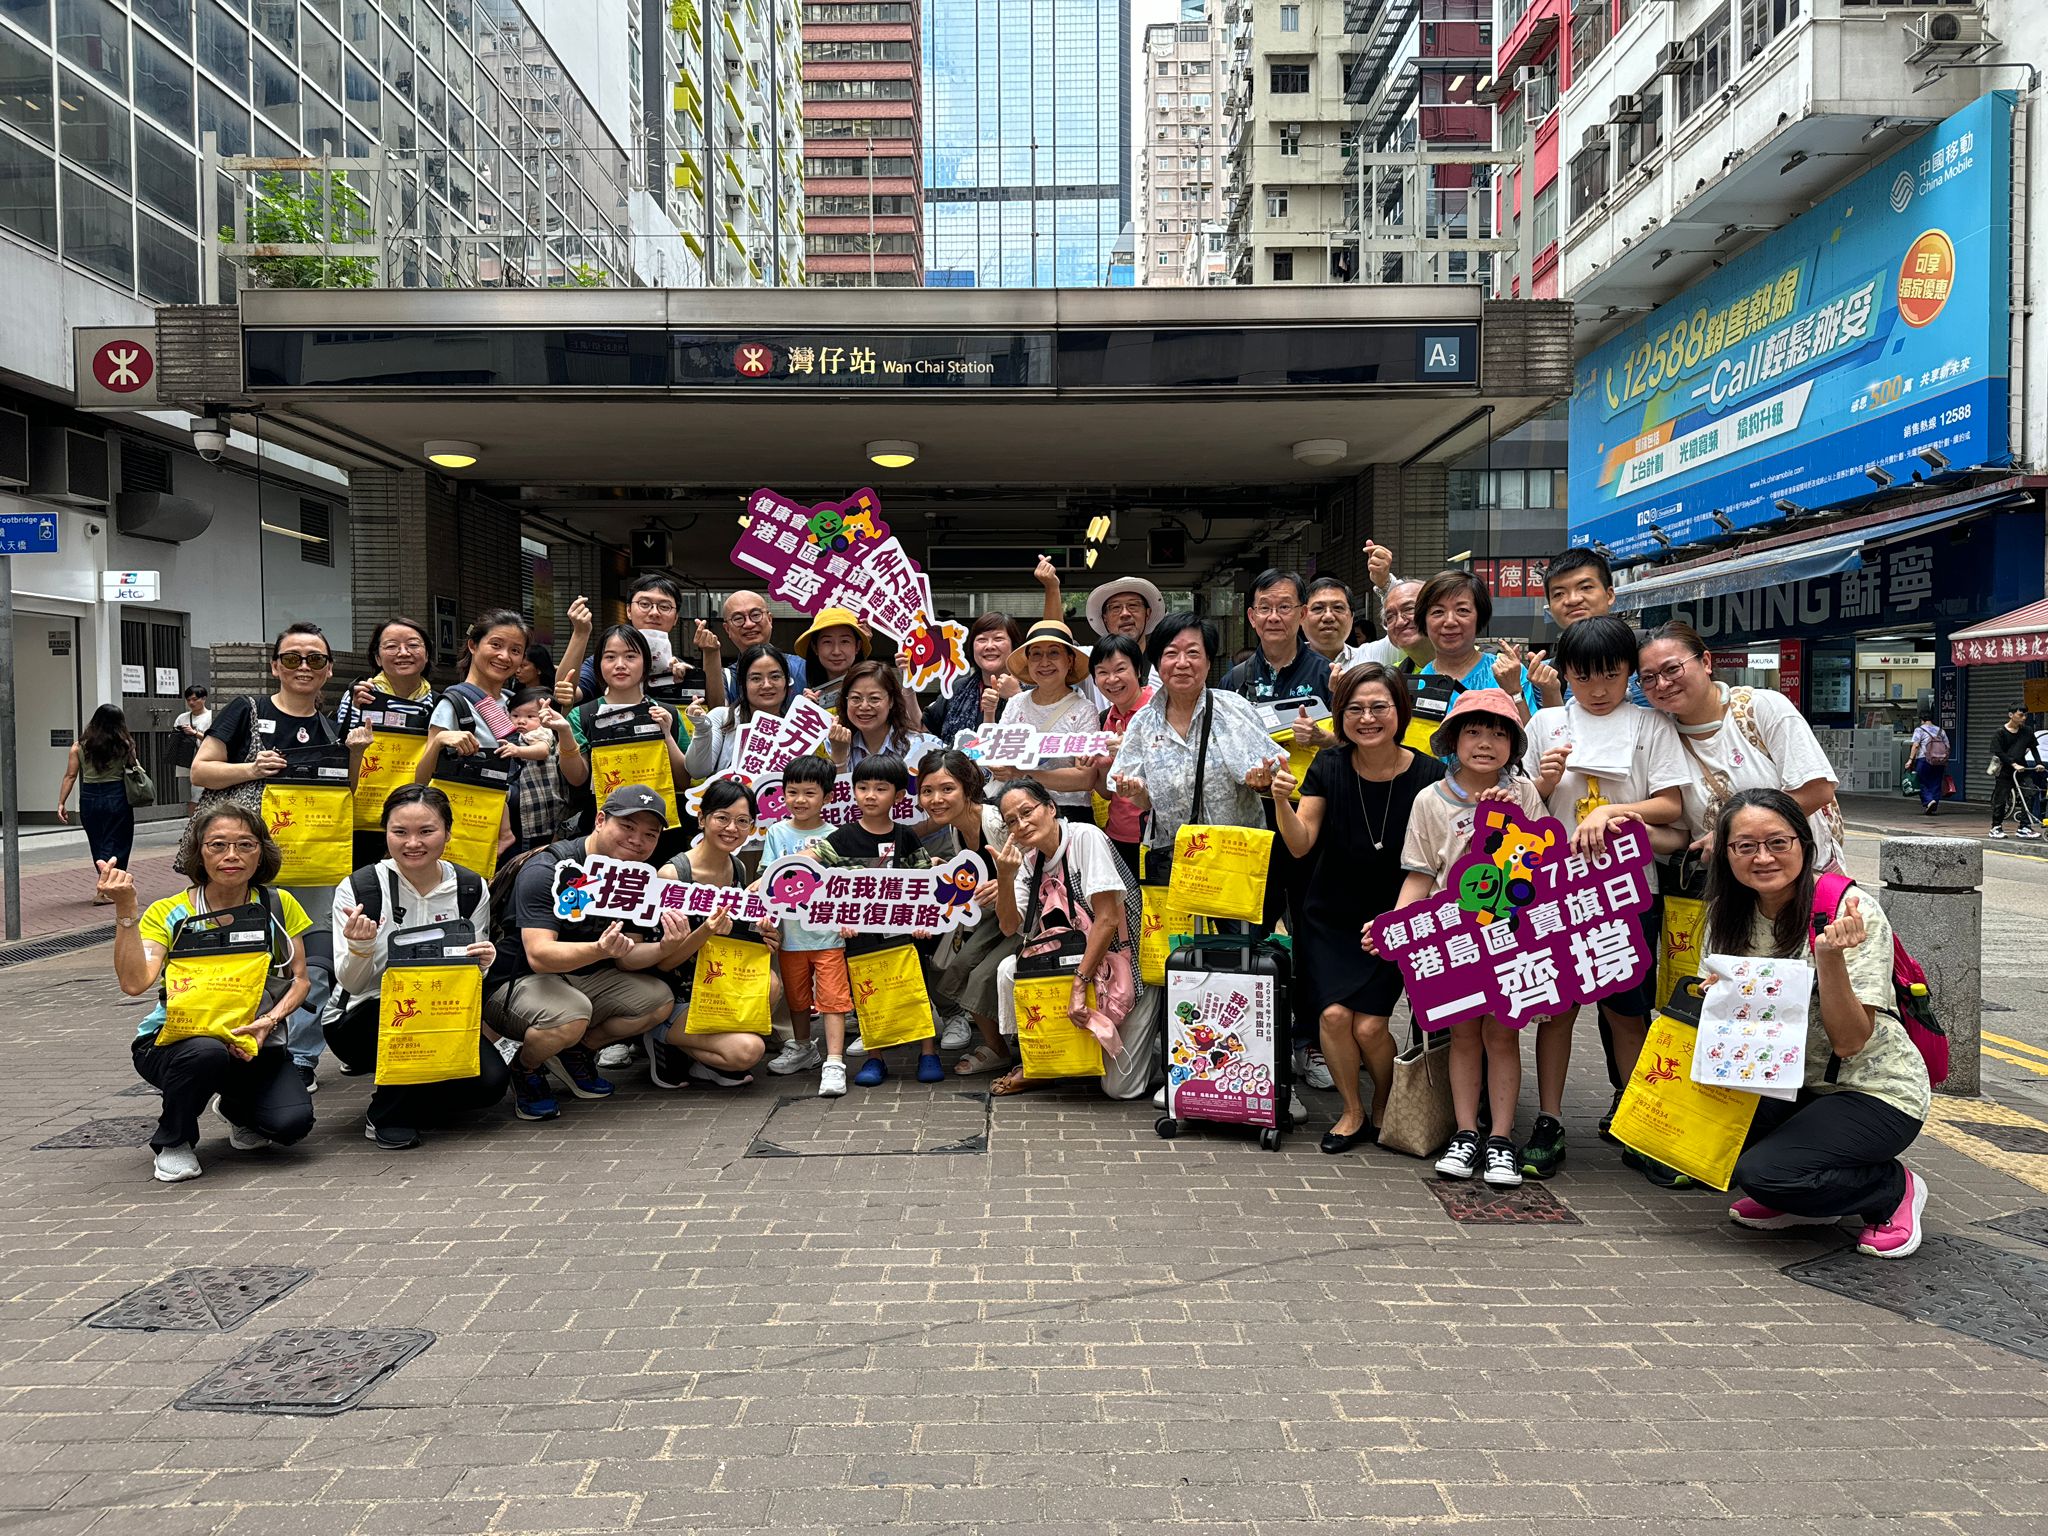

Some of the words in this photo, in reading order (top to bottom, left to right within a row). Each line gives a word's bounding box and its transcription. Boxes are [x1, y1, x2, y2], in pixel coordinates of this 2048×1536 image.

[1919, 131, 1973, 179] 中國移動
[1919, 175, 1943, 196] China
[1943, 156, 1973, 183] Mobile
[1915, 252, 1942, 274] 可享
[1899, 278, 1949, 301] 獨家優惠
[787, 346, 876, 375] 灣仔站
[883, 361, 912, 374] Wan
[916, 360, 944, 374] Chai
[947, 360, 994, 374] Station
[1428, 343, 1457, 367] A3
[1737, 401, 1784, 440] 續約升級
[1903, 415, 1937, 439] 銷售熱線
[1940, 404, 1972, 426] 12588
[1630, 451, 1664, 483] 上台計劃
[1679, 429, 1719, 464] 光纖寬頻
[755, 496, 809, 530] 復康會
[752, 519, 823, 565] 港島區
[871, 547, 922, 614] 全力撐
[868, 587, 913, 633] 感謝您
[743, 715, 782, 775] 感謝您
[825, 875, 930, 901] 你我攜手
[1526, 873, 1641, 940] 賣旗日
[808, 901, 941, 927] 撐起復康路
[1382, 902, 1464, 950] 復康會
[1408, 917, 1519, 981] 港島區
[392, 979, 442, 993] 請支持
[1426, 918, 1640, 1021] 一齊撐
[1218, 990, 1248, 1029] 我地撐
[1255, 982, 1264, 1008] 港島區
[1256, 1012, 1264, 1037] 賣旗日
[1656, 1030, 1695, 1057] 請支
[1635, 1096, 1650, 1110] 2872
[1651, 1106, 1669, 1119] 8934
